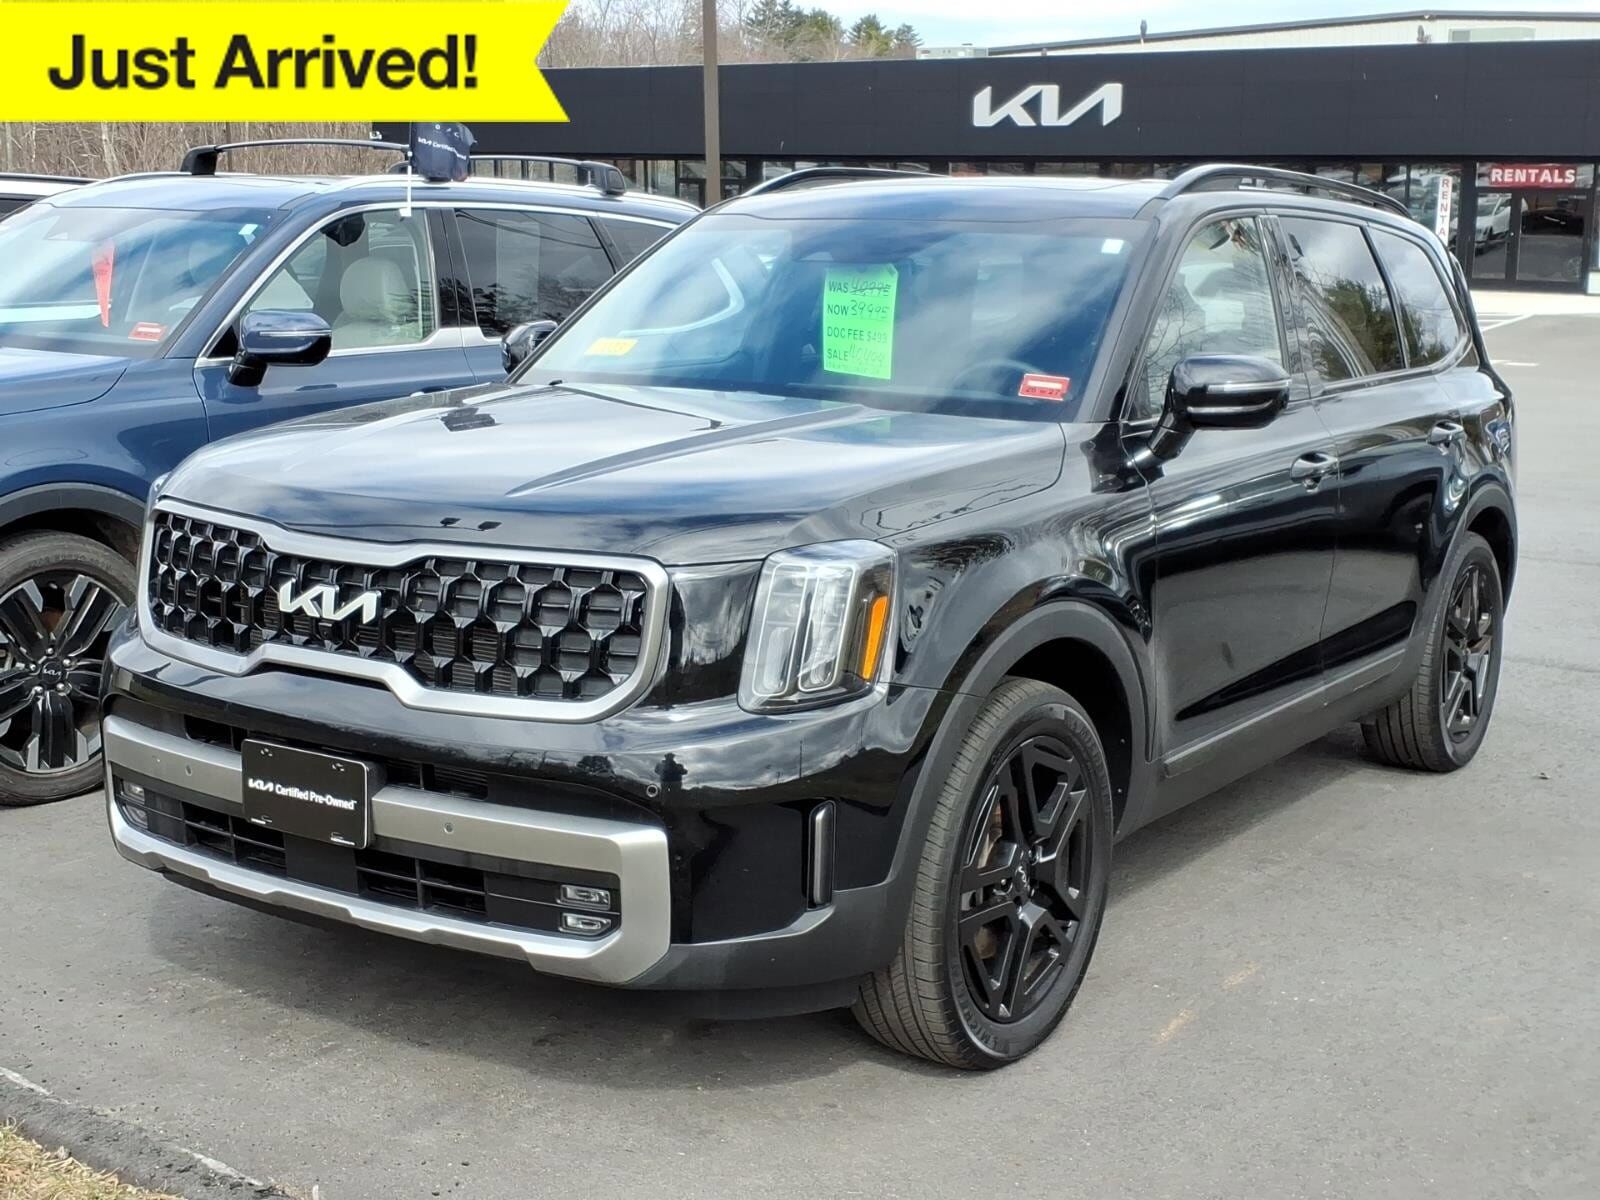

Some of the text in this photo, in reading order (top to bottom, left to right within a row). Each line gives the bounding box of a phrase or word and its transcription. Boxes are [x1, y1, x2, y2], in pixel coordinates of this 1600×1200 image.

[973, 83, 1123, 127] KIA
[1490, 168, 1576, 184] RENTALS
[828, 280, 849, 294] WAS
[827, 303, 849, 316] NOW
[827, 326, 846, 339] DOC
[847, 328, 865, 341] FEE
[826, 348, 849, 361] SALE
[279, 578, 381, 624] KIA
[248, 778, 274, 792] KIA
[275, 784, 309, 801] Certified
